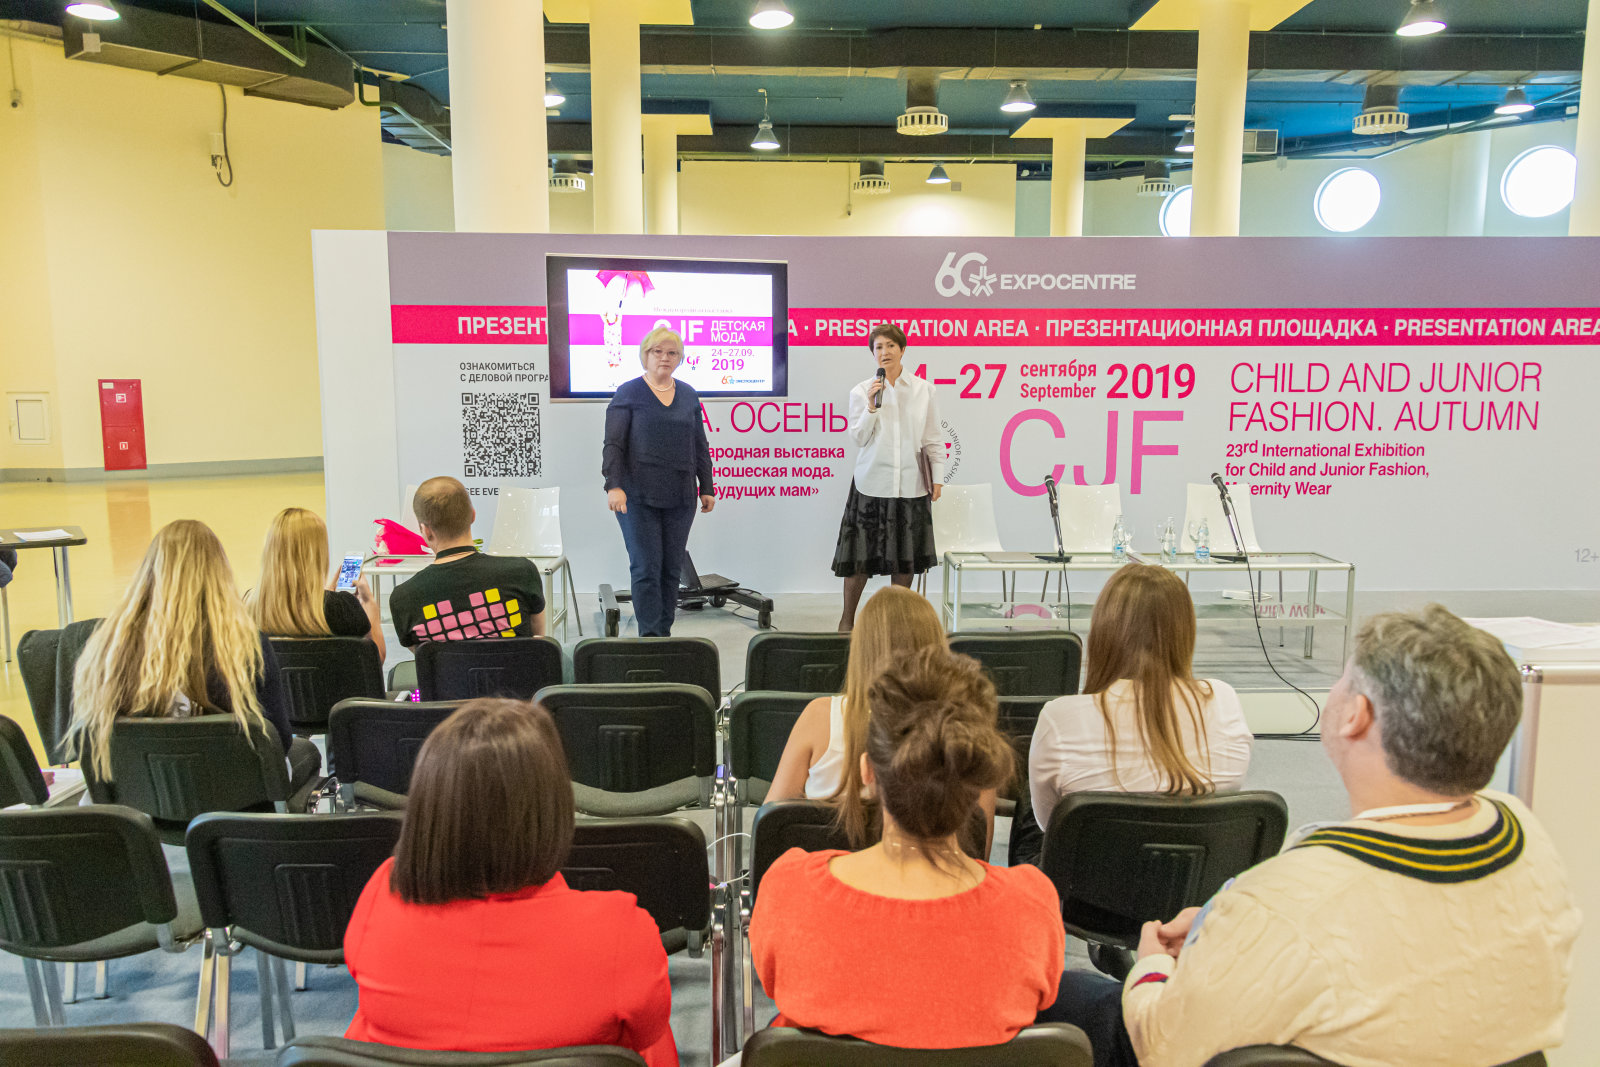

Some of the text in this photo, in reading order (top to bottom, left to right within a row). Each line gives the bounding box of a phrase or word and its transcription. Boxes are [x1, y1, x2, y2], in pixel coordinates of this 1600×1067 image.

[1000, 274, 1137, 290] EXPOCENTRE
[710, 320, 765, 332] ДЕТСКАЯ
[816, 319, 1029, 337] PRESETATION AREA
[1046, 319, 1377, 339] ПРЕЗЕНТАЦИОННАЯ ПЛОЩАДКА
[1395, 318, 1600, 336] PRESENTATION AREA
[711, 332, 746, 344] МОДА
[459, 362, 535, 371] ОЗНАКОМИТЬСЯ
[711, 358, 745, 371] 2019
[1020, 359, 1097, 381] сентября
[460, 374, 466, 382] С
[468, 372, 513, 383] ДЕЛОВОЙ
[1106, 363, 1196, 399] 2019
[1230, 361, 1543, 394] CHILD AND JUNIOR
[1020, 383, 1097, 402] September
[730, 401, 849, 433] ОСЕНЬ
[1228, 400, 1540, 432] FASHION. AUTUMN
[947, 428, 962, 456] JUNIOR
[1226, 440, 1425, 457] 23rd International Exhibition
[774, 447, 845, 458] выставка
[1000, 408, 1185, 497] CJF
[791, 467, 835, 480] мода.
[1225, 461, 1430, 478] for Child and Junior Fashion,
[466, 487, 500, 496] EE EVE
[780, 486, 819, 497] мам»
[1225, 481, 1332, 499] ernity Wear
[1574, 547, 1600, 563] 12+
